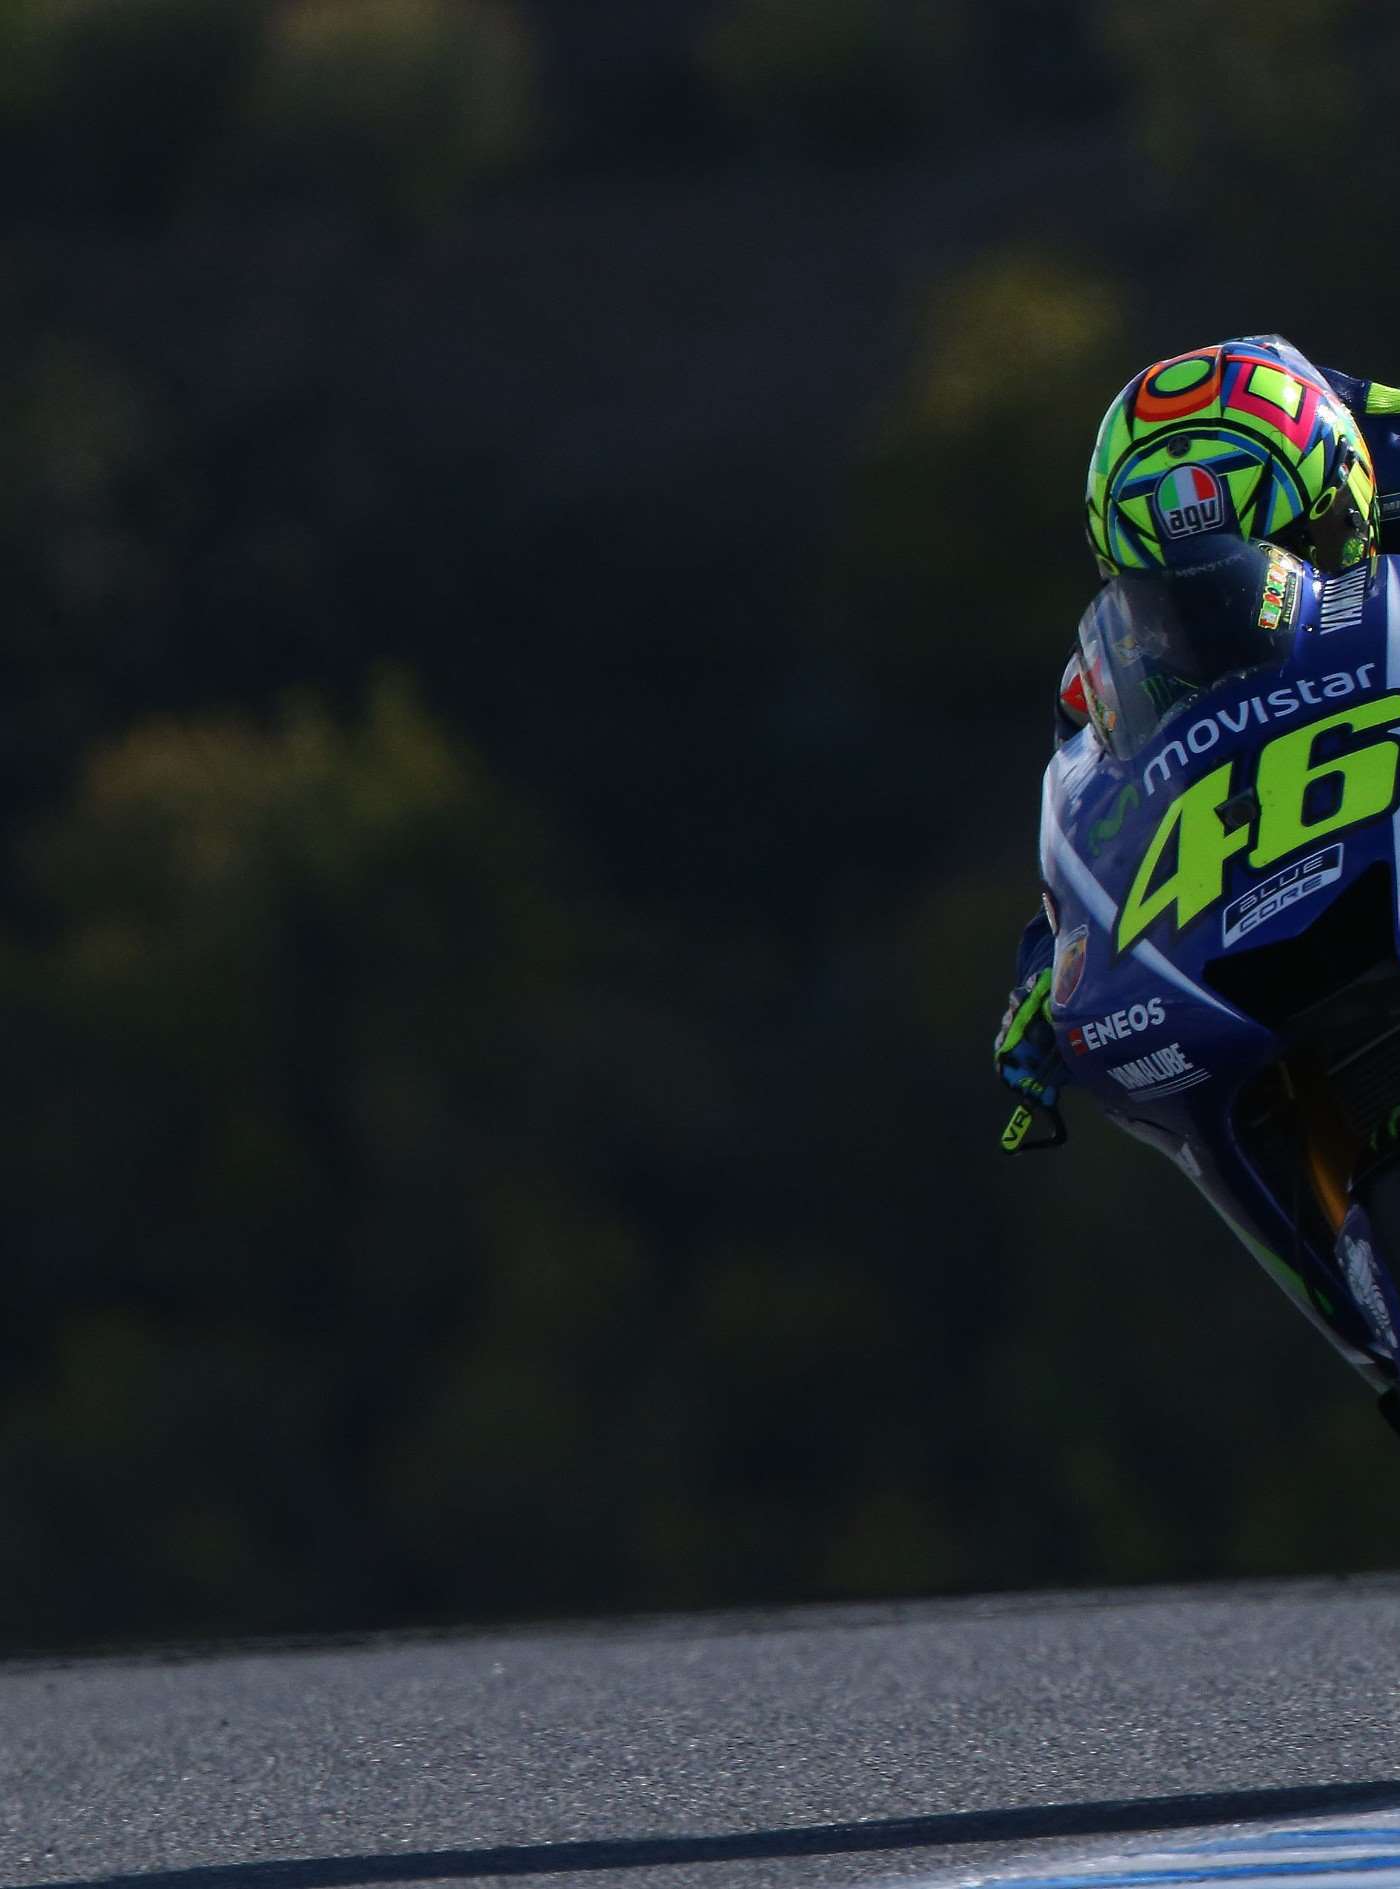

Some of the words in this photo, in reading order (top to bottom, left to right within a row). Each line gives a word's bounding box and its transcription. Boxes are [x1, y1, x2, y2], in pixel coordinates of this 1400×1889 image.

[1168, 499, 1216, 534] agv
[1320, 565, 1367, 635] YAMAHA
[1142, 662, 1377, 796] movistar
[1240, 856, 1324, 914] BLUE
[1240, 875, 1322, 933] CORE
[1082, 998, 1166, 1050] ENEOS
[1107, 1043, 1194, 1089] YAMALUBE
